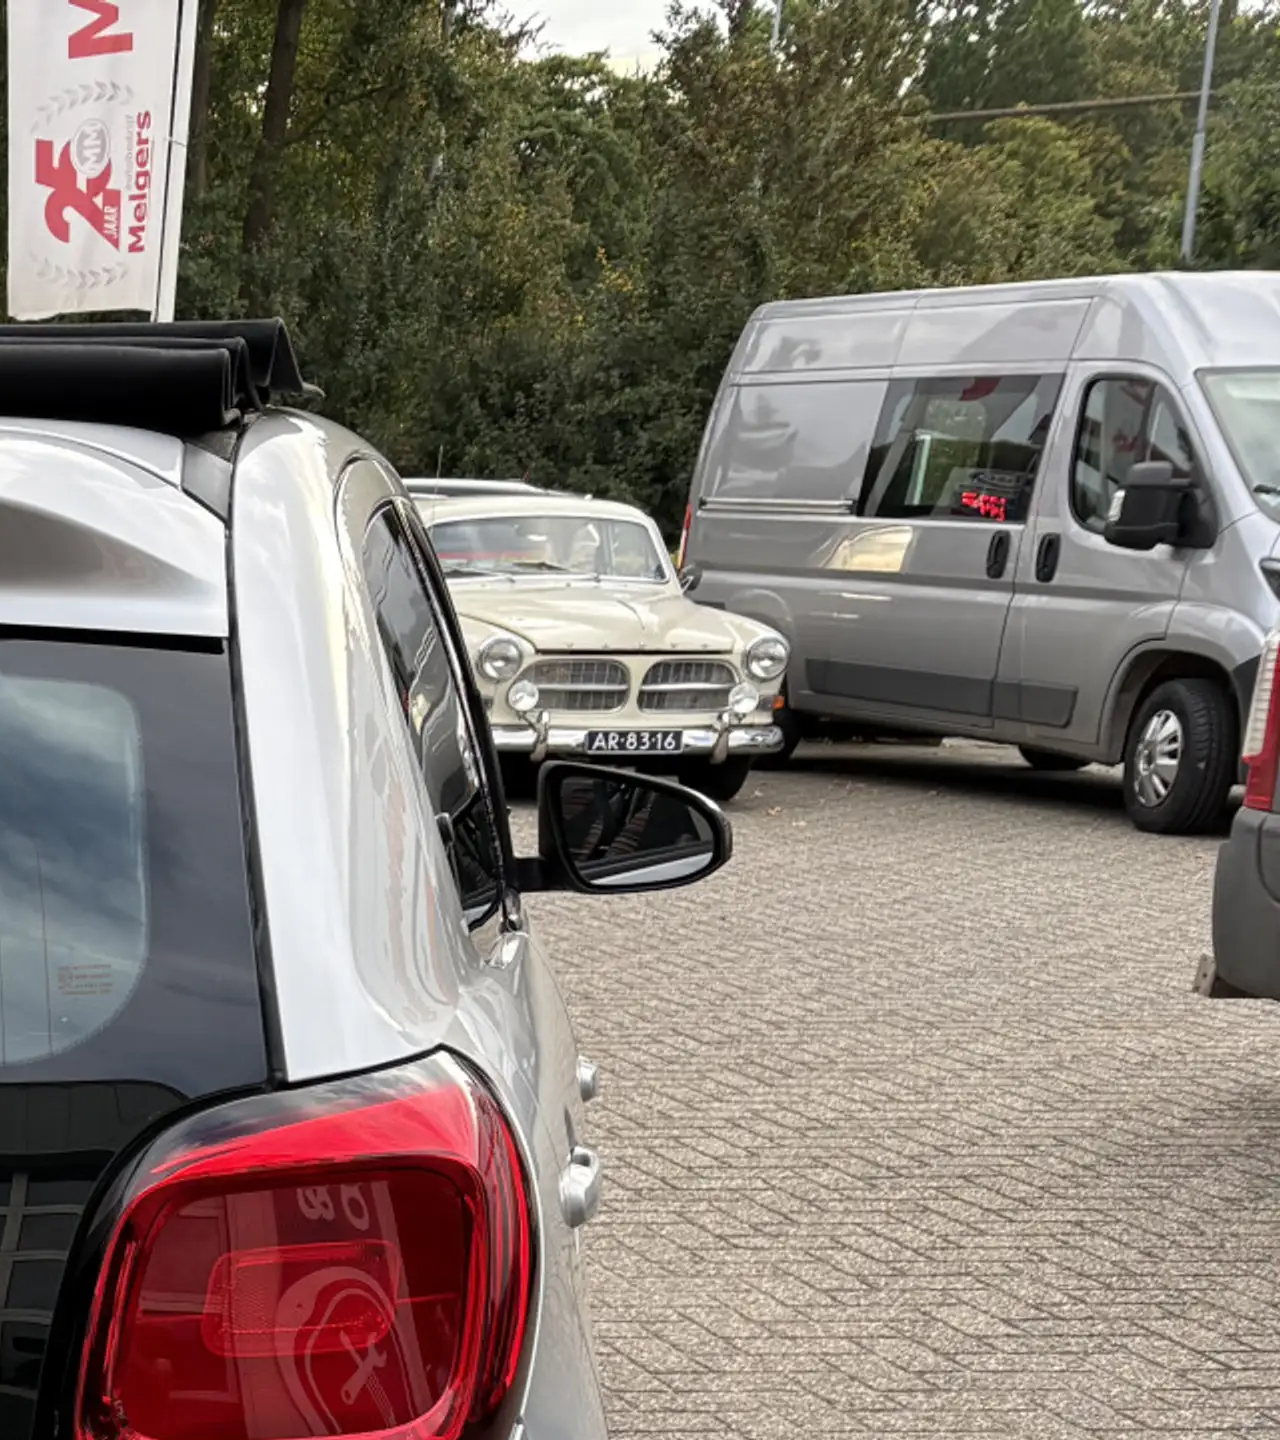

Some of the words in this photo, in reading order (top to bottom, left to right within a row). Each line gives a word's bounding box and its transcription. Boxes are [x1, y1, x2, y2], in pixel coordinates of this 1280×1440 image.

[83, 125, 102, 172] MM
[127, 109, 151, 254] Melgers
[103, 205, 118, 239] JAAR
